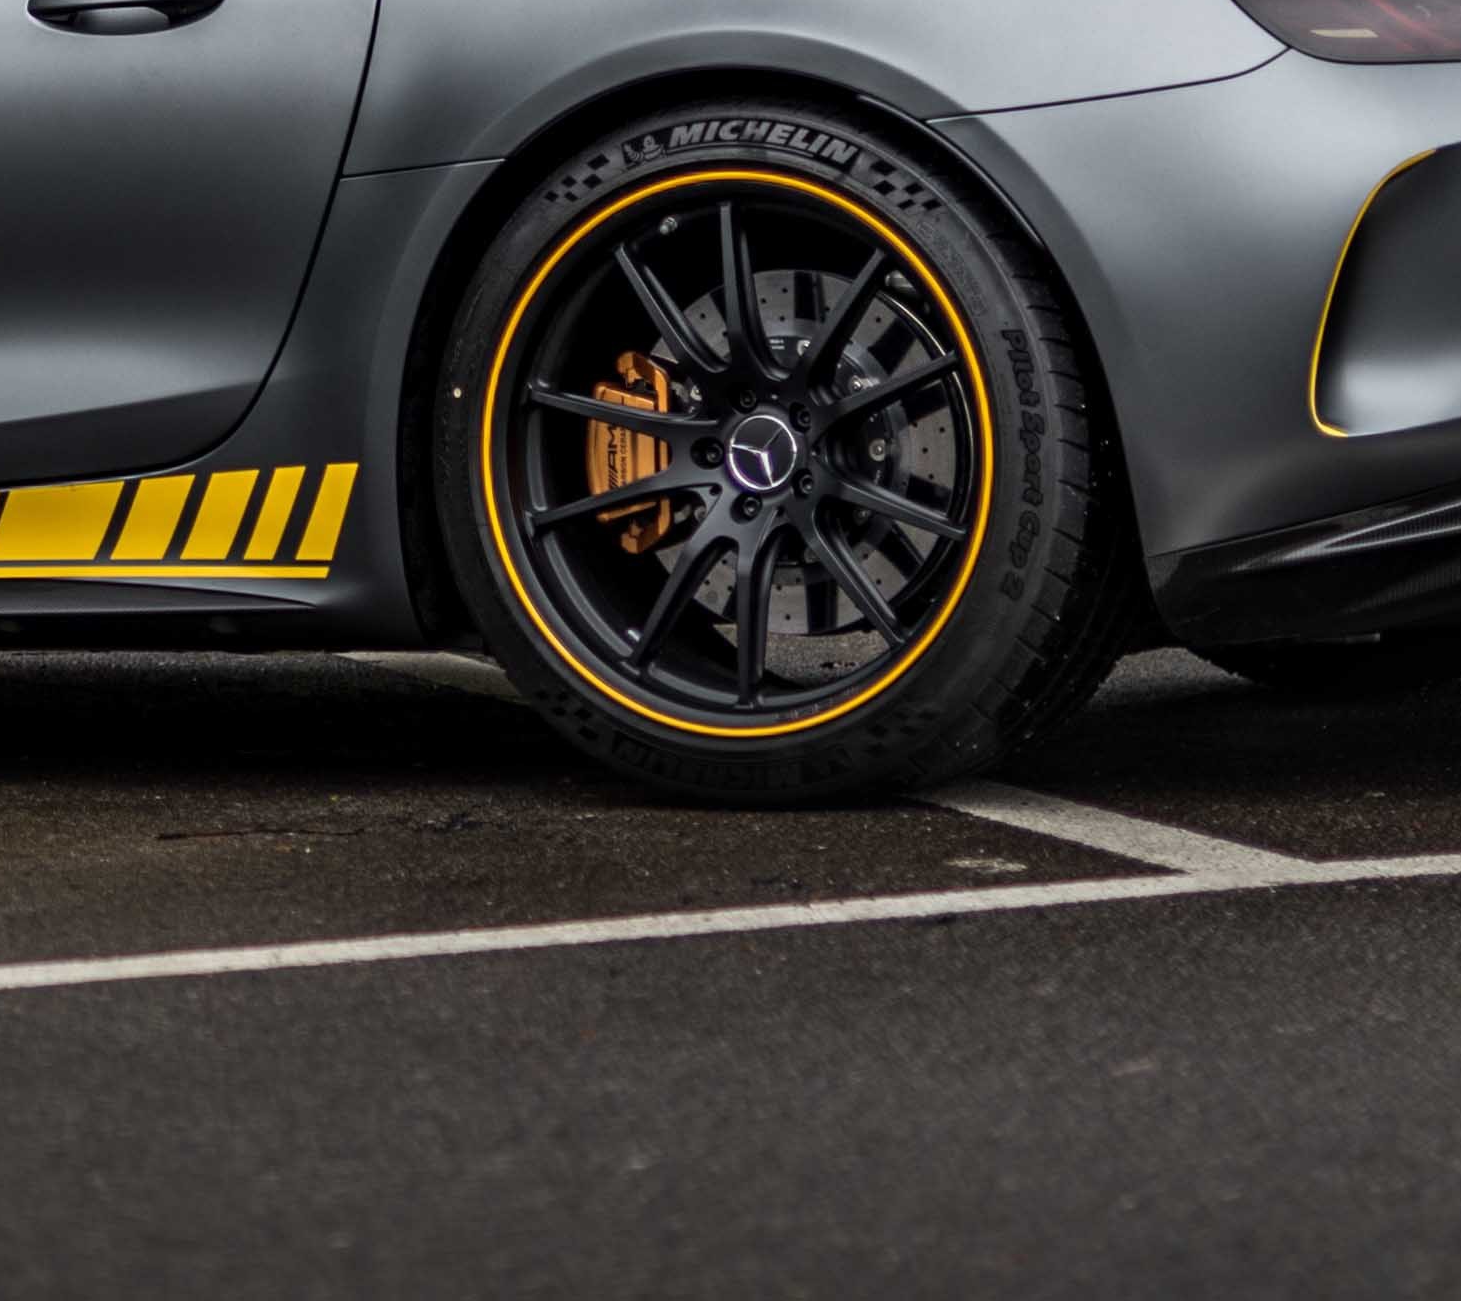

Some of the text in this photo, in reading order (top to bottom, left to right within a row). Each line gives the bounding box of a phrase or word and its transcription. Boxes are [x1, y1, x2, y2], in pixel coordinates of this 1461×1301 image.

[669, 119, 858, 165] MICHELIN
[1000, 329, 1045, 600] Pilot Sport Cup 2
